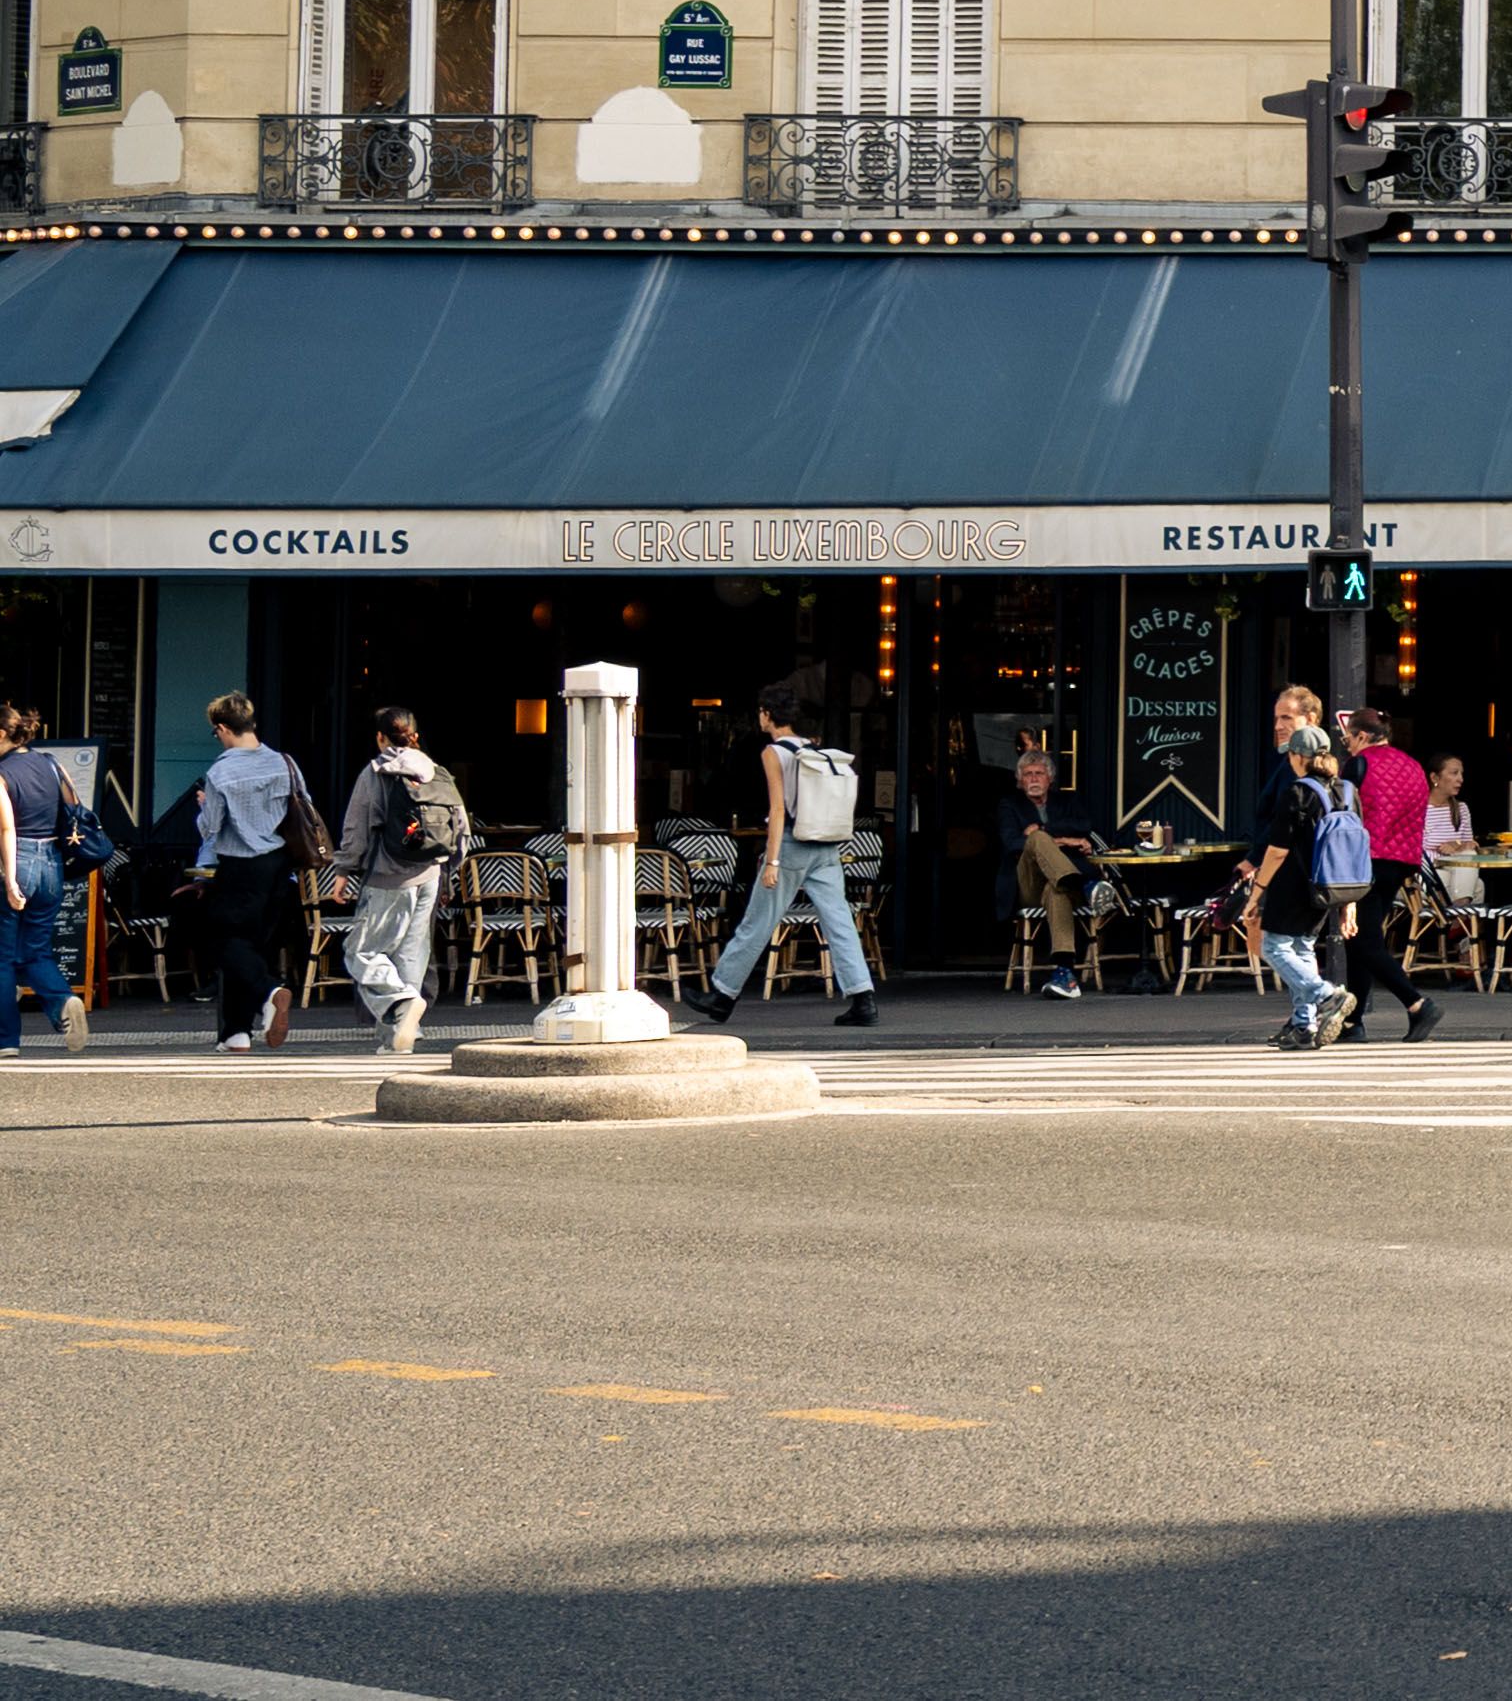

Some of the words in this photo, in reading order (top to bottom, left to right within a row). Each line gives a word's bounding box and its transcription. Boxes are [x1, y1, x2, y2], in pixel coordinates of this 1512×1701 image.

[686, 39, 704, 48] RUE
[668, 54, 686, 64] GAY
[688, 55, 721, 64] LUSSAC
[68, 64, 110, 80] BOULEVARD
[66, 87, 87, 100] SAINT
[88, 84, 112, 98] MICHEL
[208, 528, 410, 556] COCKTAILS
[562, 519, 594, 562] LE
[612, 520, 734, 562] CERCLE
[752, 519, 1027, 562] LUXEMBOURG
[1163, 522, 1398, 551] RESTAURNT
[1130, 608, 1212, 639] CRÊPES
[1133, 650, 1215, 679] GLACES
[1128, 696, 1218, 717] DESSERTS
[1136, 724, 1204, 746] Maison
